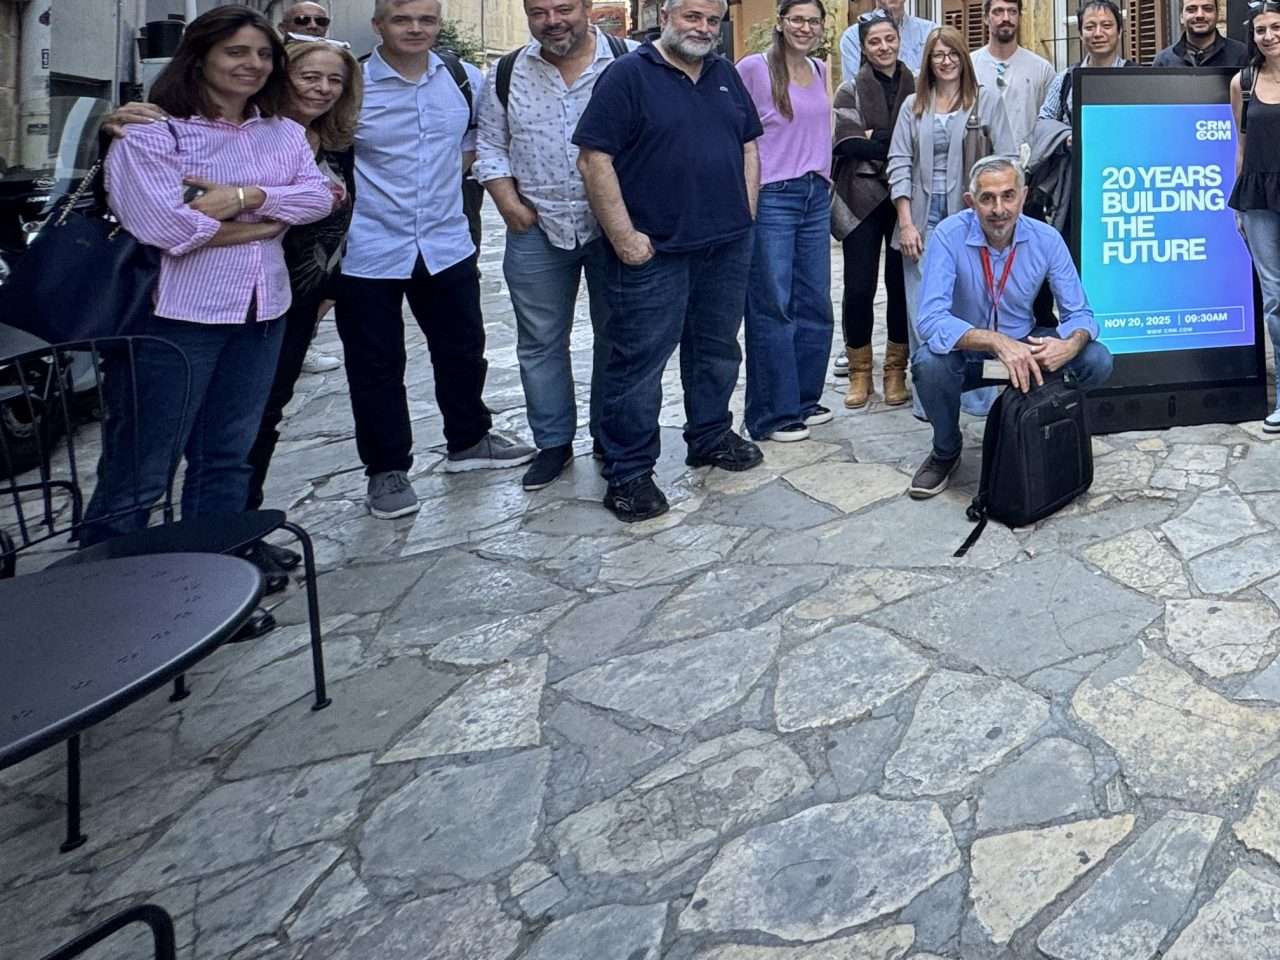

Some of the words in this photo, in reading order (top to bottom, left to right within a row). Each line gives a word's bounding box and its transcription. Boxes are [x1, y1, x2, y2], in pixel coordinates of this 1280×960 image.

[1195, 120, 1231, 130] CRM
[1102, 166, 1136, 189] 20
[1137, 165, 1222, 188] YEARS
[1102, 188, 1225, 214] BUILDING
[1101, 215, 1155, 239] THE
[1103, 238, 1207, 264] FUTURE
[1104, 318, 1126, 328] NOV
[1128, 317, 1143, 328] 20,
[1146, 315, 1171, 325] 2025
[1184, 312, 1228, 324] 09:30AM
